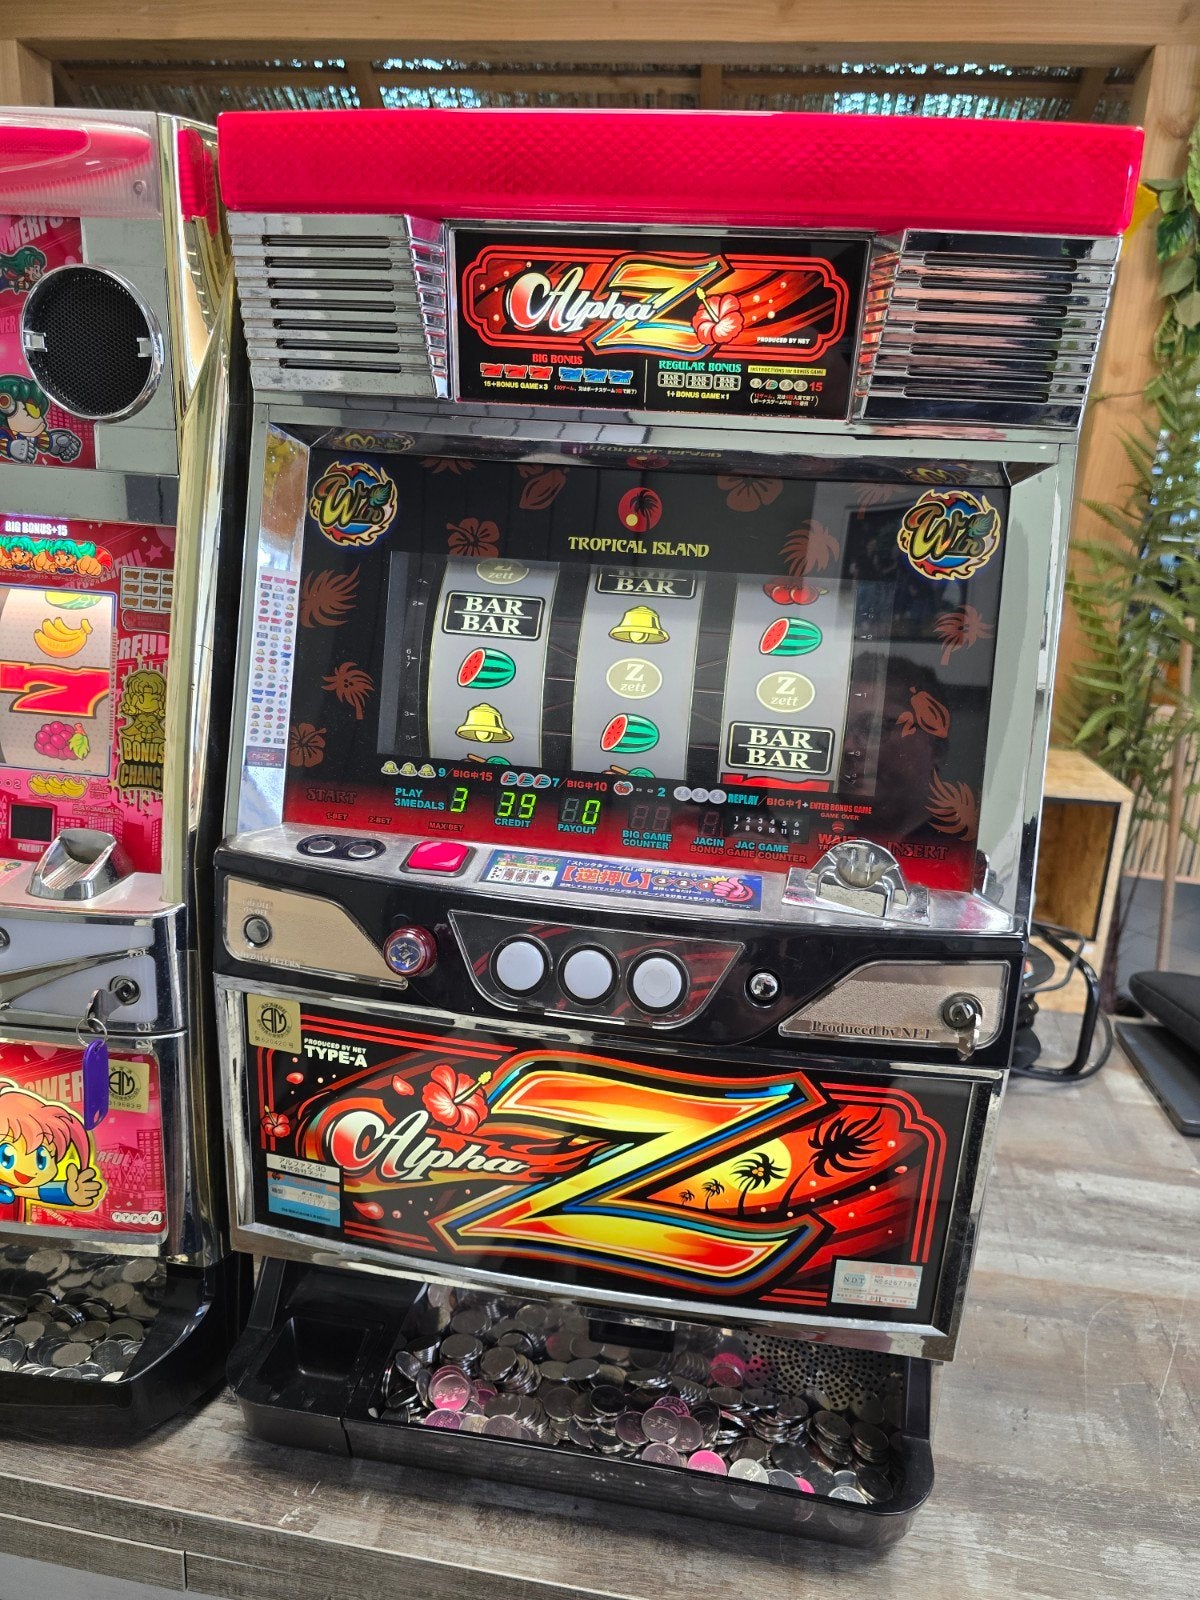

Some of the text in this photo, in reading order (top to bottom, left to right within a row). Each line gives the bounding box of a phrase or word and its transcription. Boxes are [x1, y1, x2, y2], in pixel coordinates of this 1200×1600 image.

[508, 254, 734, 357] Alpha Z
[532, 354, 583, 365] BIG BONUS
[658, 360, 742, 373] REGULAR BONUS
[810, 382, 823, 392] 15
[5, 521, 21, 533] BIG
[568, 536, 710, 557] TROPICAL ISLAND
[614, 578, 677, 595] BAR
[463, 597, 525, 615] BAR
[460, 614, 522, 635] BAR
[624, 664, 644, 681] Z
[620, 682, 647, 693] zett
[774, 677, 796, 695] Z
[770, 696, 799, 707] zett
[747, 728, 814, 750] BAR
[745, 749, 811, 769] BAR
[120, 762, 164, 788] CHANC
[306, 788, 357, 804] START
[395, 787, 423, 798] PLAY
[450, 787, 469, 813] 3
[657, 787, 666, 797] 2
[394, 797, 445, 811] 3MEDALS
[497, 791, 537, 819] 39
[809, 802, 830, 812] ENTER
[830, 803, 853, 813] BONUS
[854, 804, 872, 814] GAME
[325, 812, 348, 821] 1-BET
[367, 816, 392, 825] 2-BET
[581, 799, 600, 826] 0
[494, 817, 531, 828] CREDIT
[557, 823, 597, 835] PAYOUT
[622, 829, 673, 842] BIG GAME
[693, 837, 724, 847] JACIN
[622, 838, 670, 850] COUNTER
[735, 841, 789, 853] JAC GAME
[887, 840, 949, 861] INSERT
[690, 845, 807, 863] BONUS GAME COUNTER
[304, 1038, 340, 1050] PRODUCED
[352, 1046, 367, 1054] NET
[304, 1045, 368, 1068] TYPE-A
[325, 1050, 828, 1294] Alpha Z
